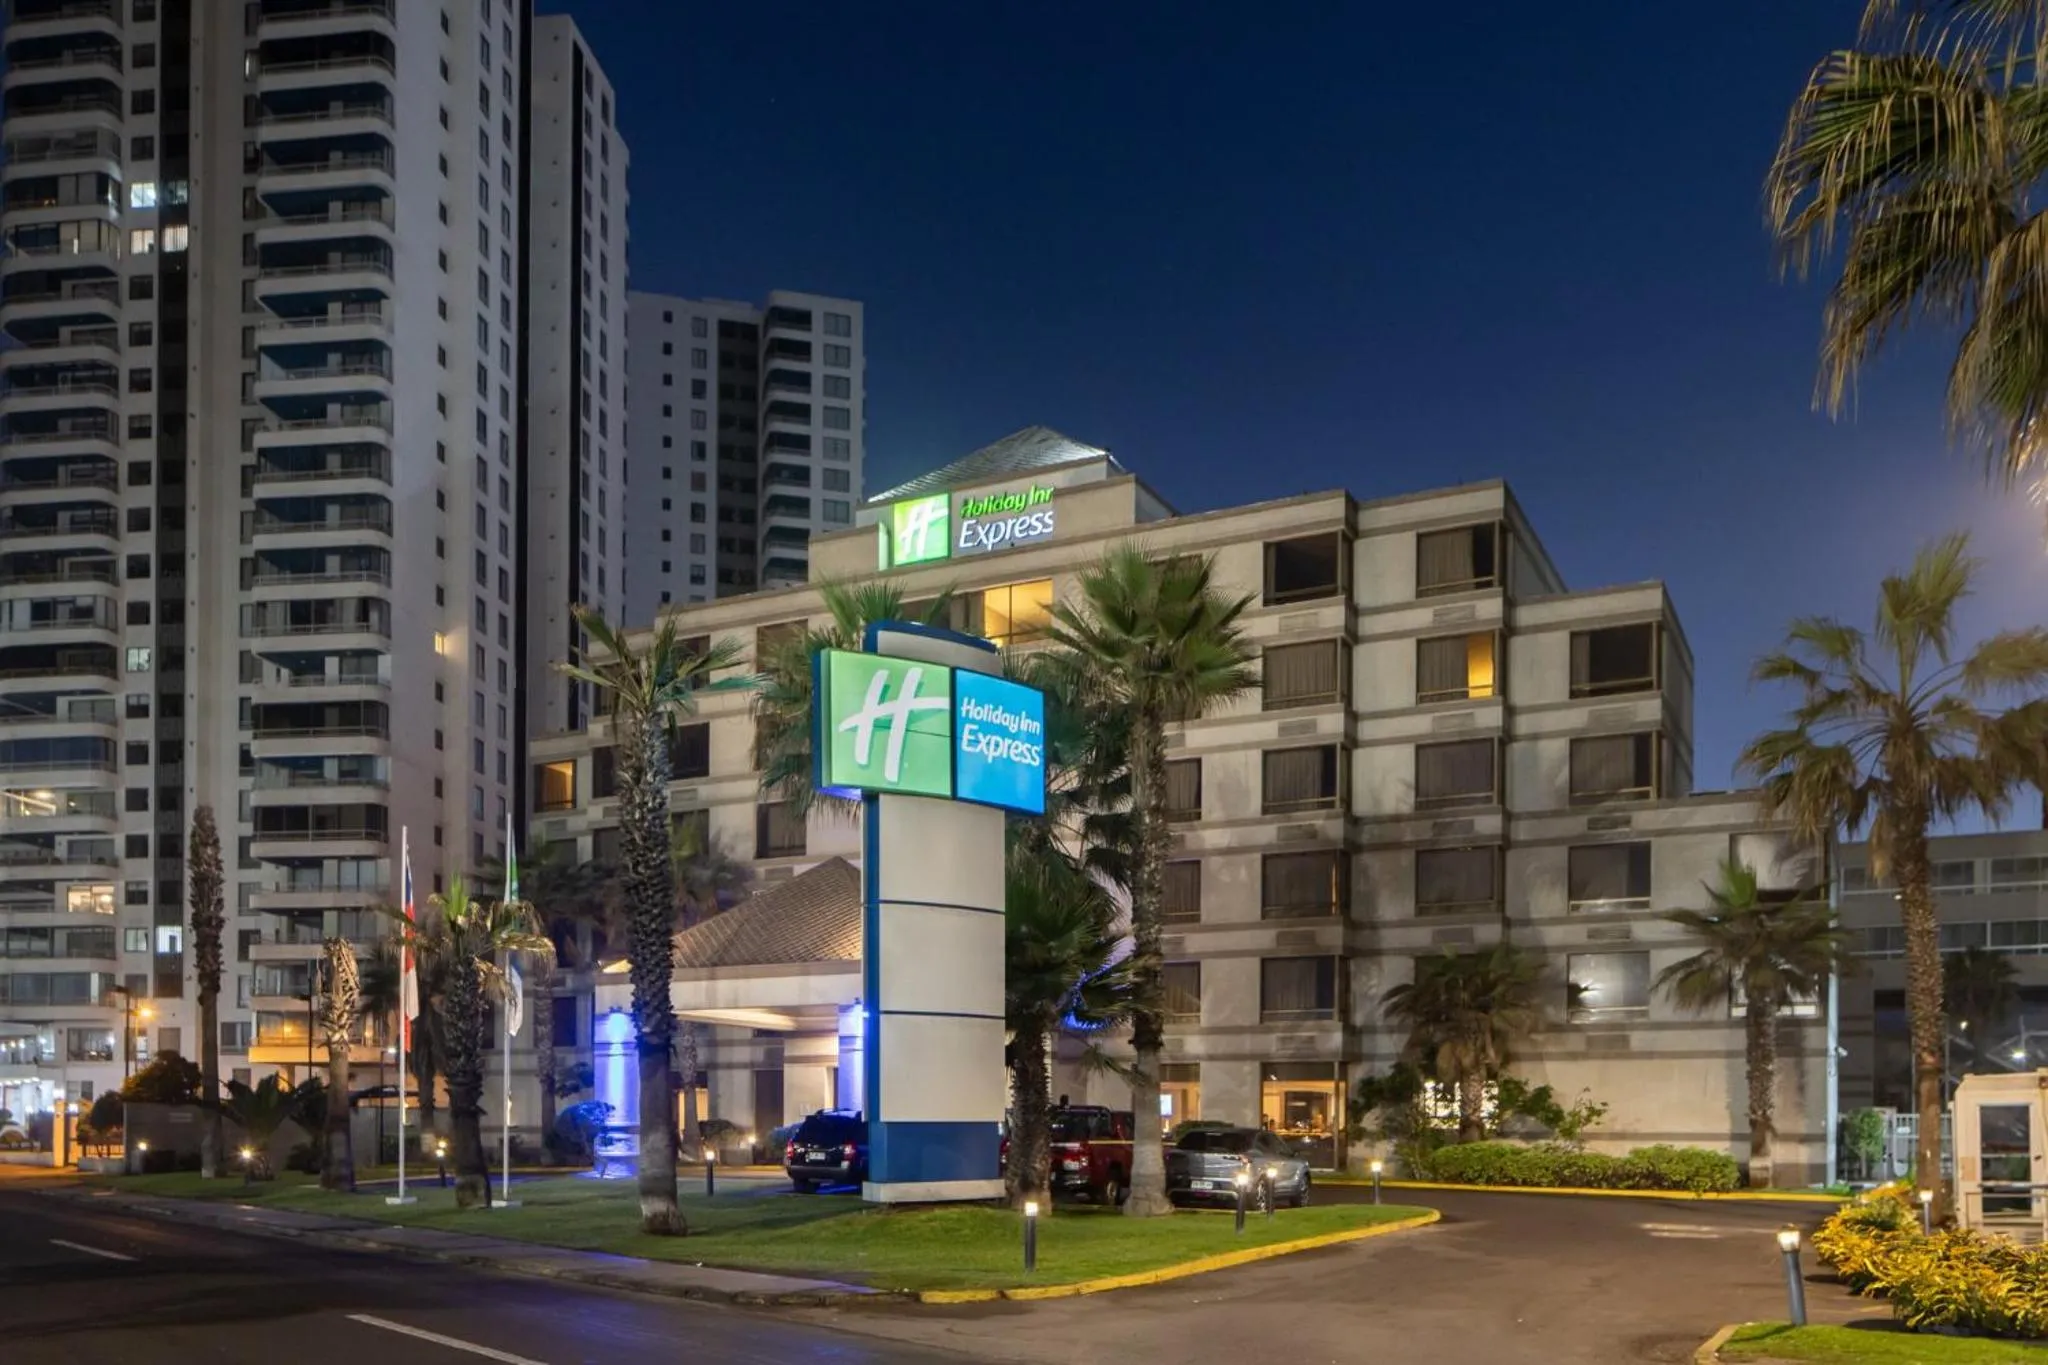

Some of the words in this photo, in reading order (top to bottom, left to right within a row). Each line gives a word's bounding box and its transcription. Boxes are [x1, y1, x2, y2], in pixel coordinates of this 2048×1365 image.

[960, 491, 1026, 519] Holiday
[959, 510, 1054, 551] Express
[961, 696, 1020, 734] Holiday
[1020, 710, 1041, 736] Inn
[961, 722, 1041, 767] Express
